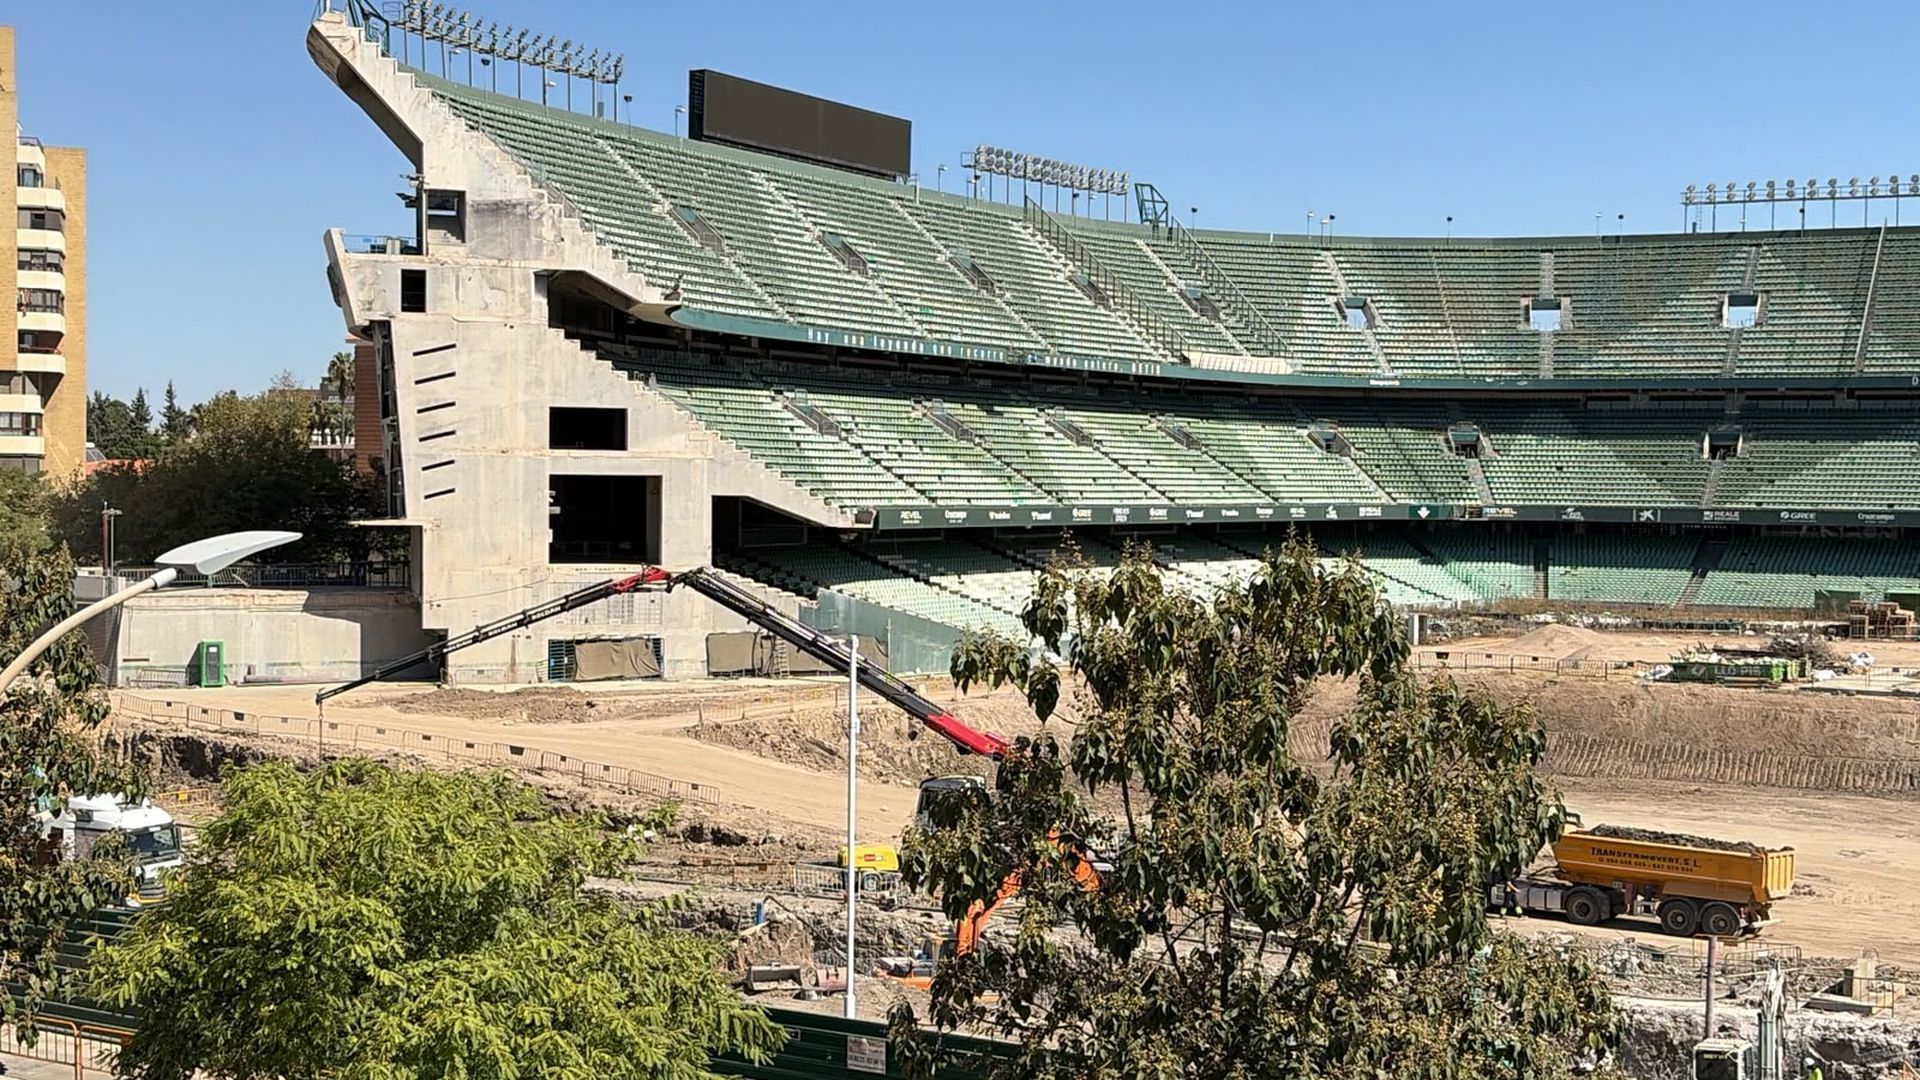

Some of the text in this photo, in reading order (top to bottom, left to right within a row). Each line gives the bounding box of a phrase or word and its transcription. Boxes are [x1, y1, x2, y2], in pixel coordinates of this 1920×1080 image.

[808, 327, 829, 343] Hay
[1482, 507, 1517, 515] REVEL
[1857, 512, 1895, 521] Cruzcampo
